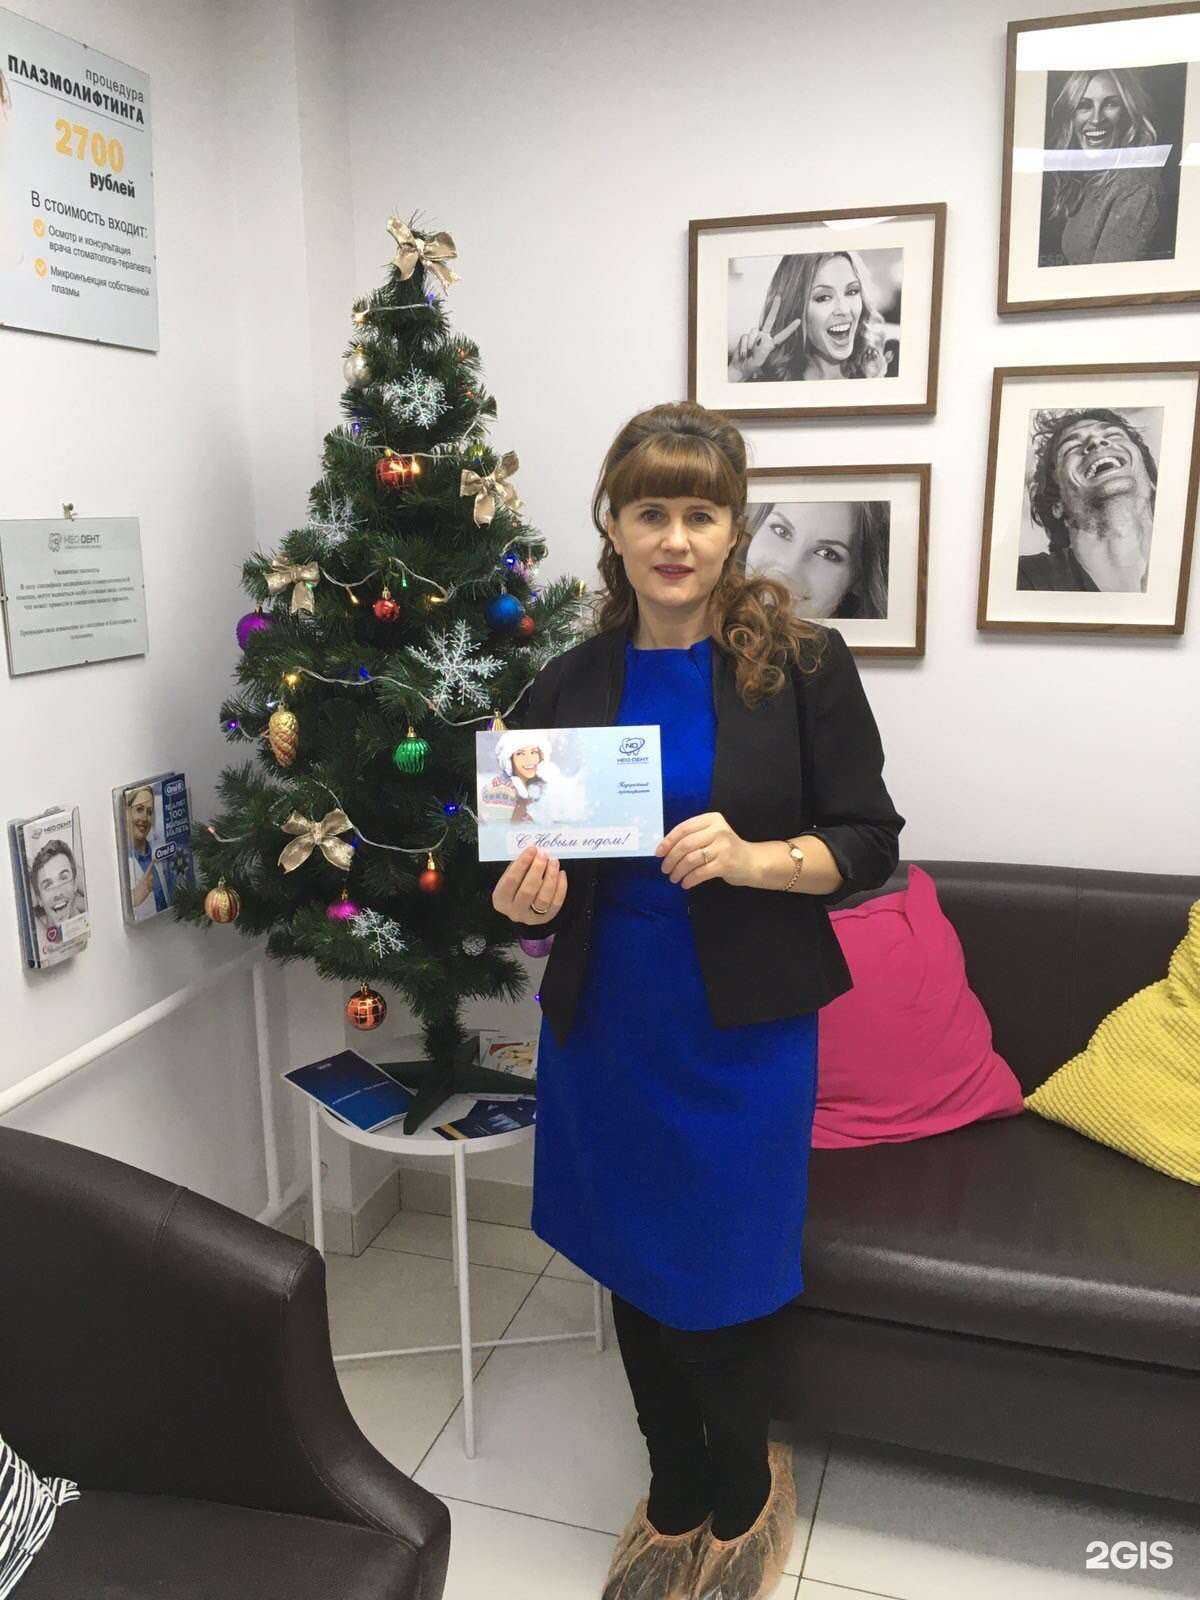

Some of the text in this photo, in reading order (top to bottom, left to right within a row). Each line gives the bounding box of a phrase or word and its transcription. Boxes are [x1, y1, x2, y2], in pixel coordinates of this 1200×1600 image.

[8, 54, 144, 125] ПЛАЗМОЛИФТИНГА
[85, 69, 144, 103] процедура
[55, 118, 124, 172] 2700
[90, 172, 135, 198] рублей
[31, 190, 148, 239] В стоимость входит:
[48, 225, 77, 243] Осмотр
[49, 242, 72, 255] врача
[51, 284, 80, 297] плазмы
[108, 280, 150, 297] собственной
[533, 831, 578, 849] Новым
[582, 832, 631, 851] годом!
